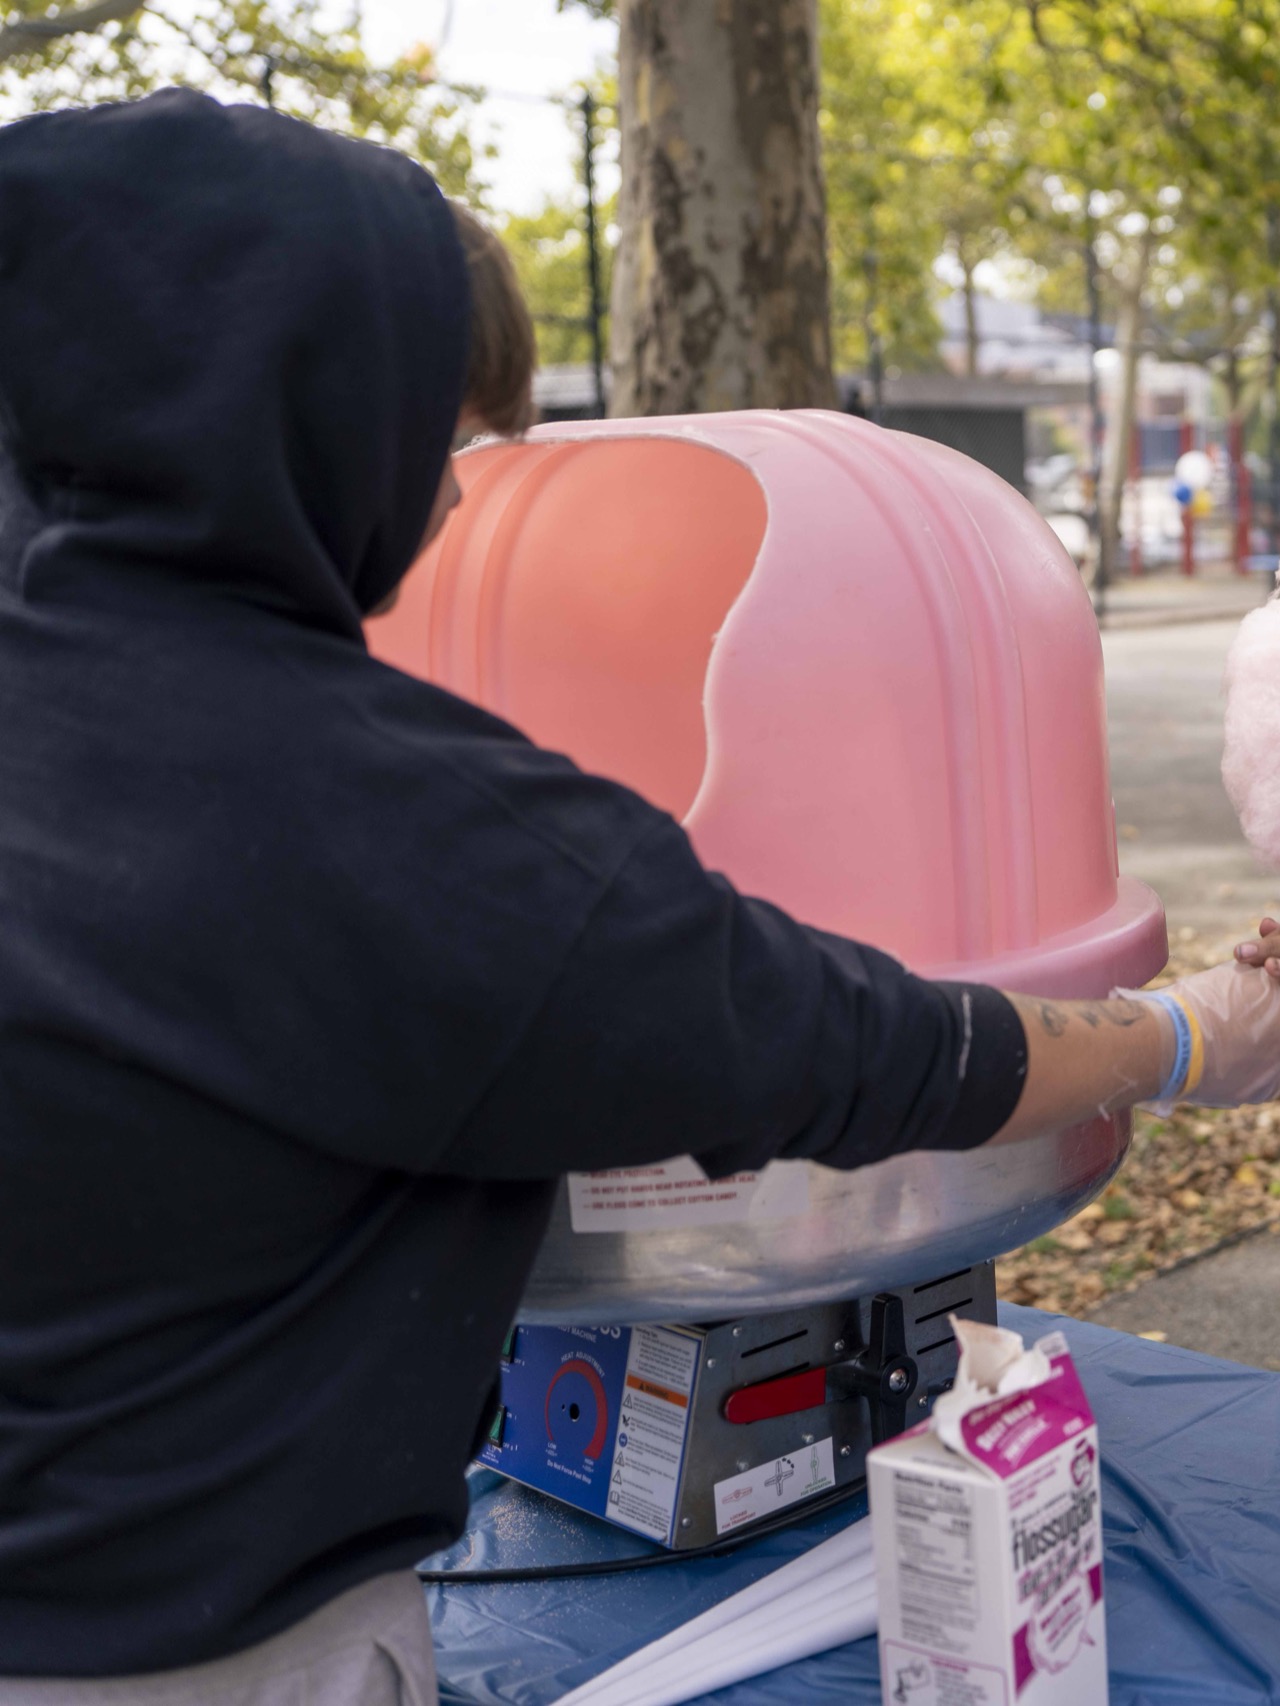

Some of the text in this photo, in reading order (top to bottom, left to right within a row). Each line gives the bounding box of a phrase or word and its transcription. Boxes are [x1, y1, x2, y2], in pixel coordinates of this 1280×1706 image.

[571, 1326, 597, 1343] MACHINE
[560, 1352, 605, 1378] HEAT ADJUSTMENT
[561, 1465, 573, 1476] Force
